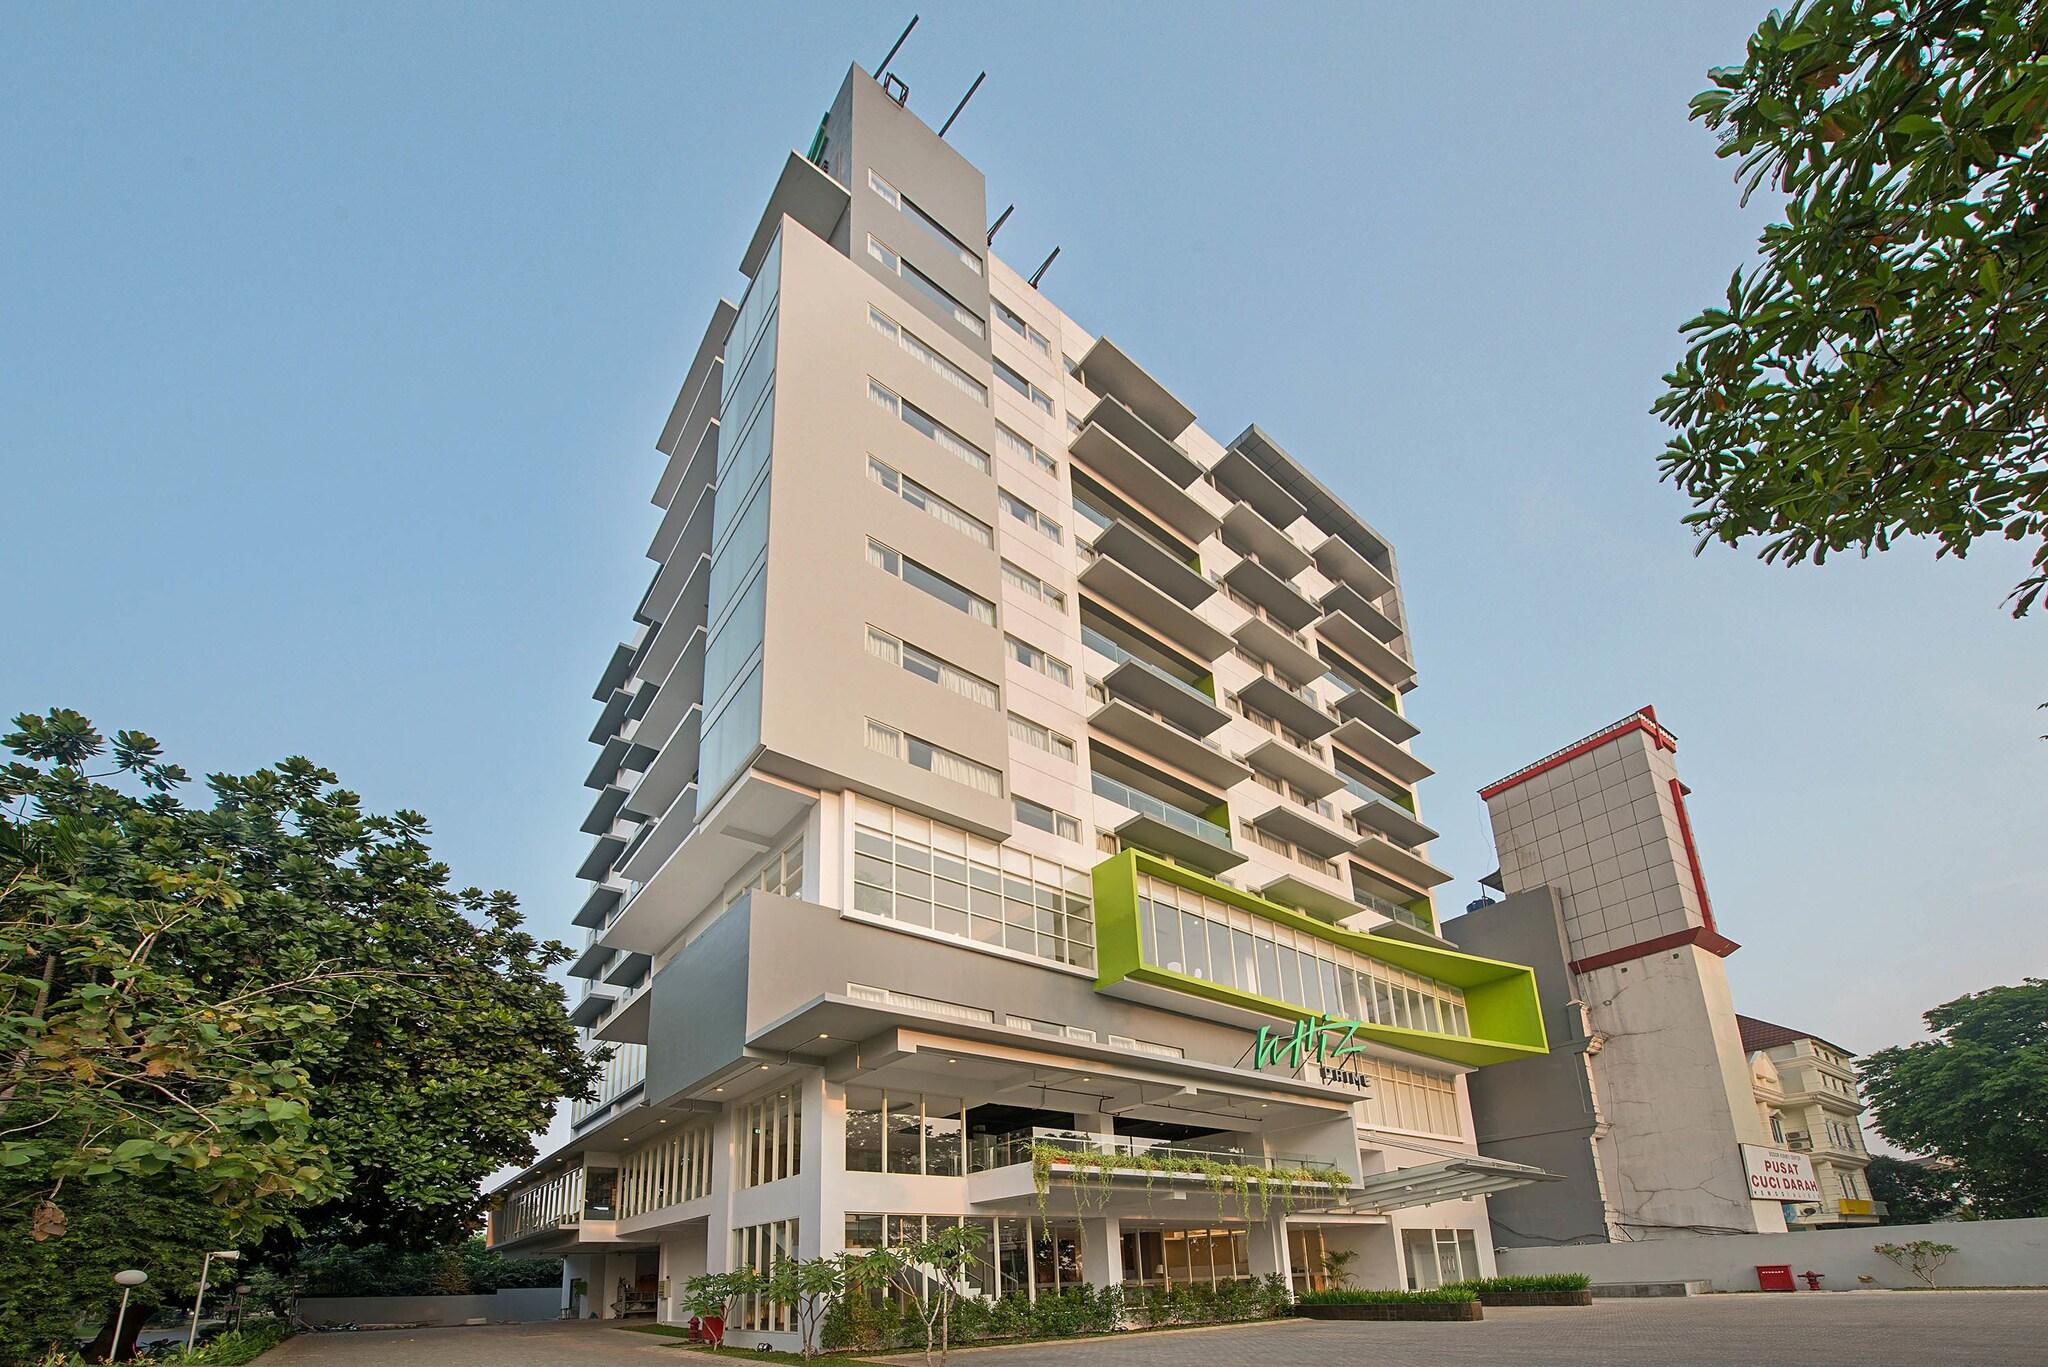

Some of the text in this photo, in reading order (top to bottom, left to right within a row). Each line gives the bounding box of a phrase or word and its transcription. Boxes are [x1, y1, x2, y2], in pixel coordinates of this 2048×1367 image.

[1319, 1067, 1371, 1088] PRIME
[1764, 1160, 1799, 1175] PUSAT
[1751, 1175, 1818, 1192] CUCI DARAH
